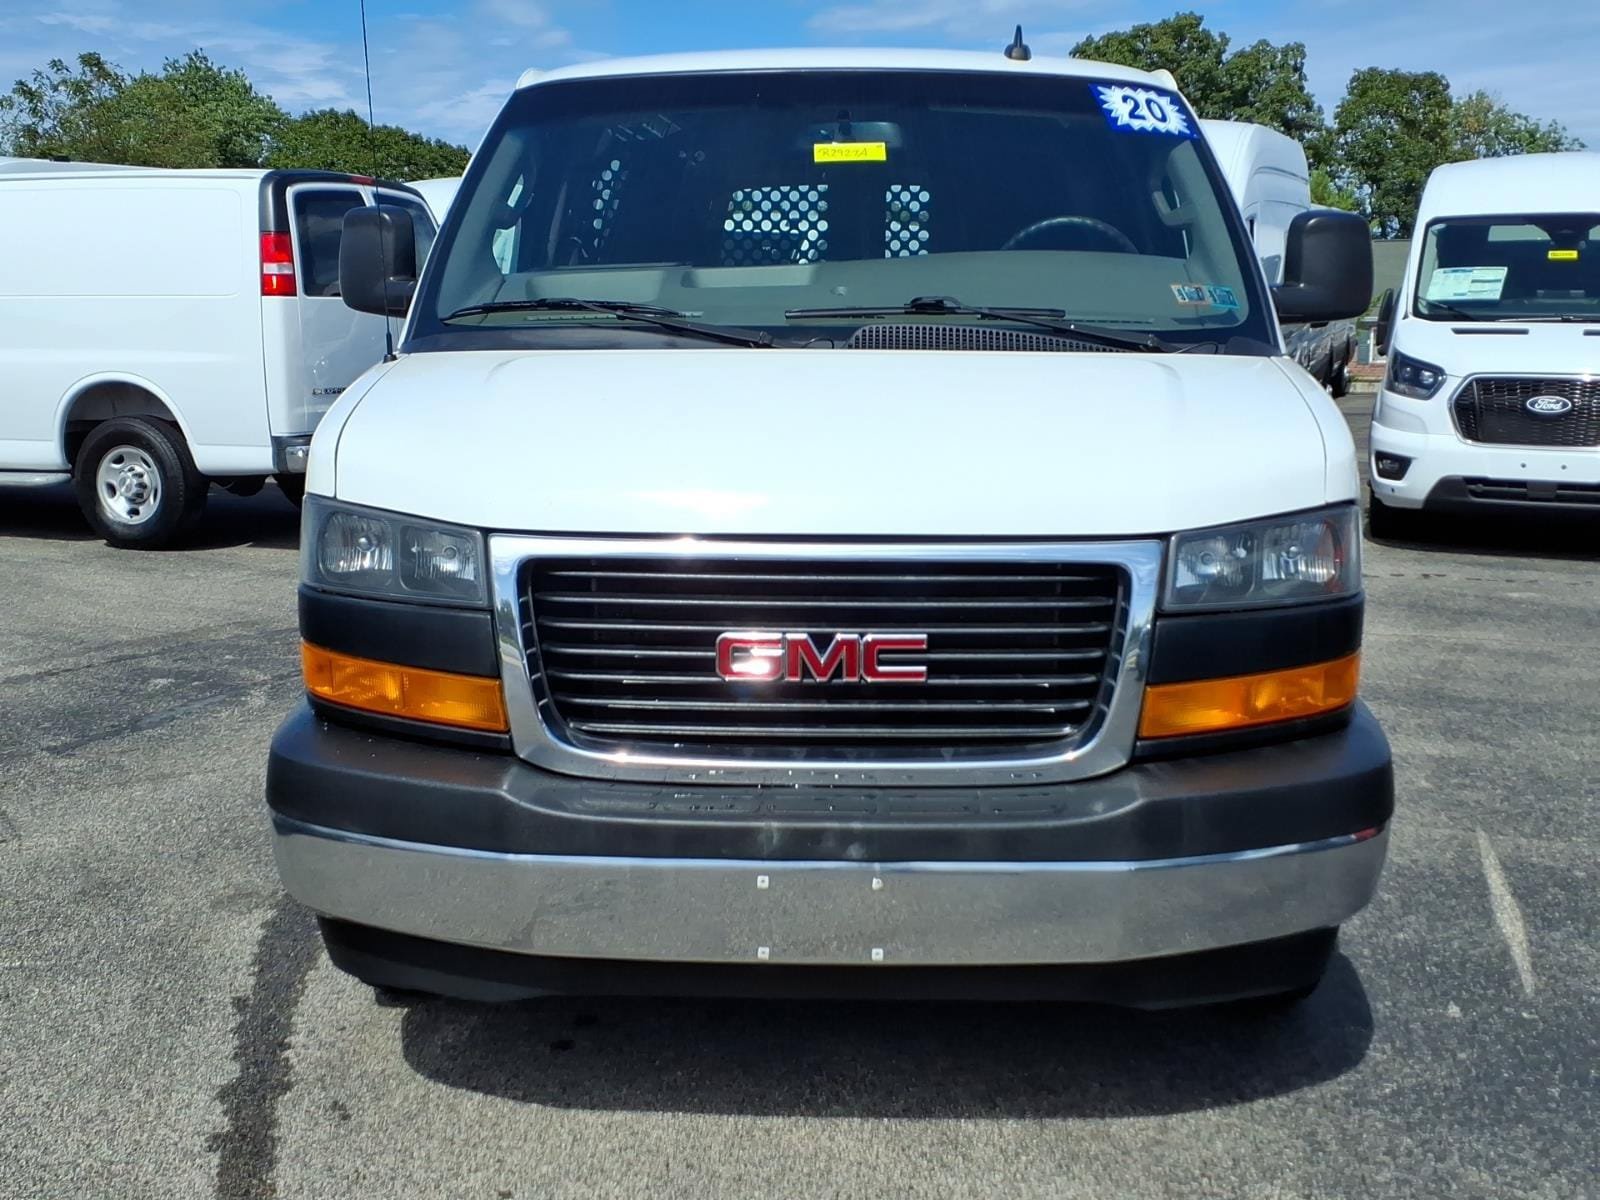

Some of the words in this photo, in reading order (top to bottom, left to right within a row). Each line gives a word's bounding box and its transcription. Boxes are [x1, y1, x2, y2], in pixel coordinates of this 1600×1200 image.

[1121, 94, 1168, 123] 20
[1534, 398, 1563, 410] Ford
[715, 631, 928, 682] GMC
